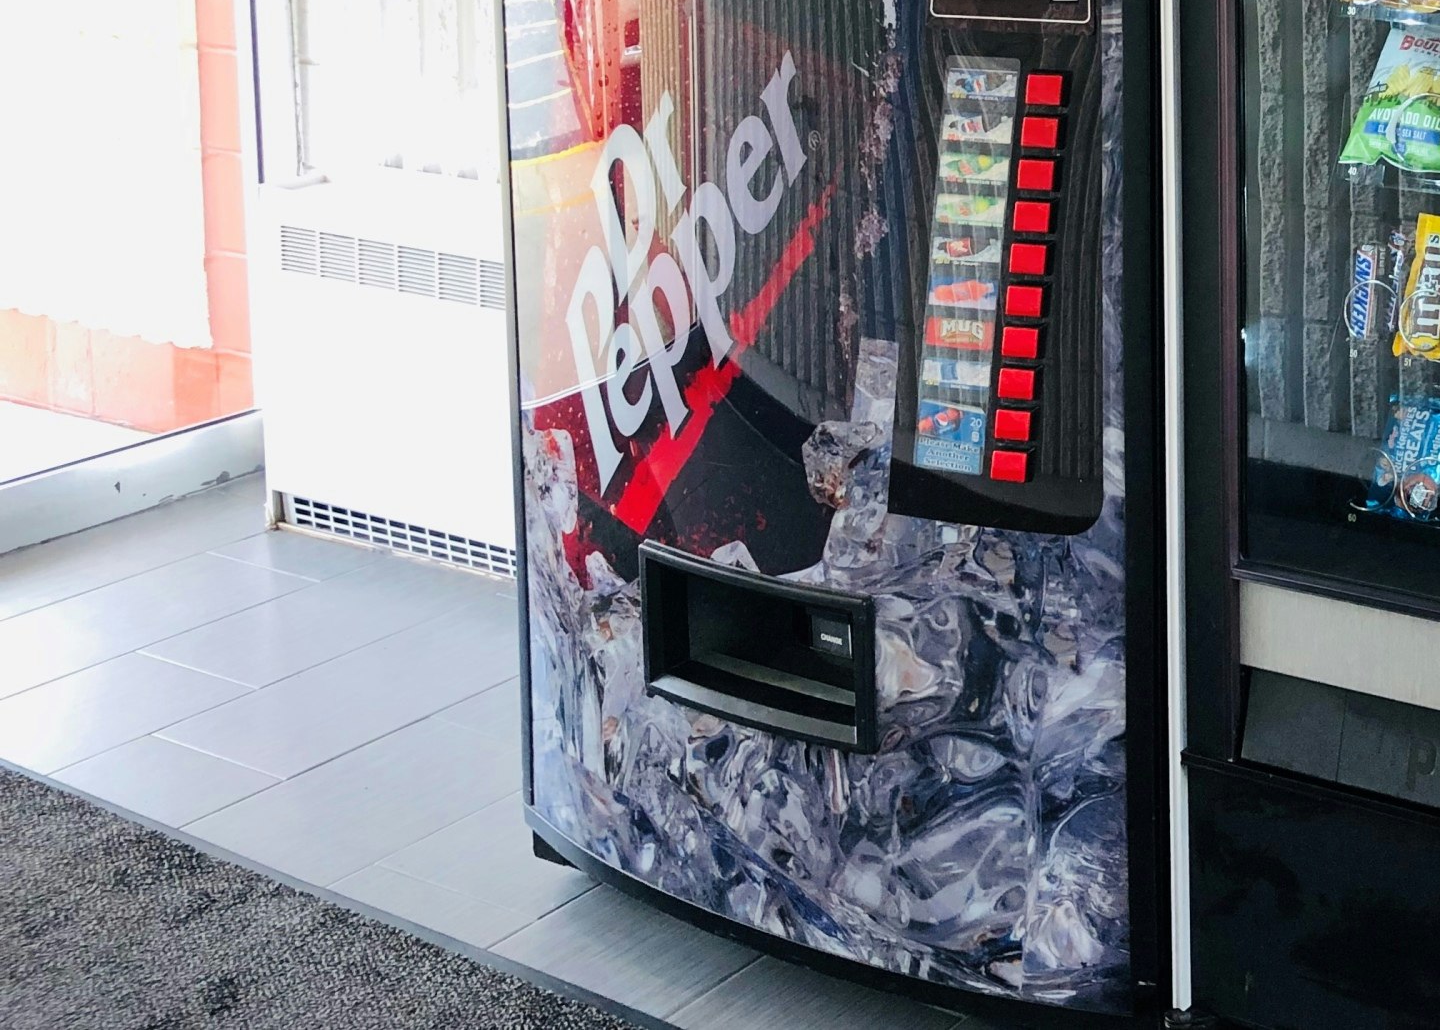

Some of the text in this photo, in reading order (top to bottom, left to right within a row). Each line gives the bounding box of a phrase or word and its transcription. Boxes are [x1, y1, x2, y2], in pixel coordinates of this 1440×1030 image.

[1347, 6, 1356, 15] 30
[1369, 108, 1420, 125] AVOADO
[1402, 128, 1427, 140] SEA SALT
[1347, 166, 1357, 176] 40
[590, 89, 688, 315] Dr
[565, 50, 808, 498] Pepper
[942, 319, 984, 340] MUG
[1403, 358, 1412, 367] 51
[970, 418, 983, 429] 20
[1398, 406, 1418, 447] KRISPIES
[1401, 409, 1431, 471] TREATS
[927, 448, 970, 462] Another
[952, 442, 980, 454] Make
[923, 457, 972, 472] Selection
[1393, 447, 1405, 474] RICE
[820, 632, 843, 646] CHANGE
